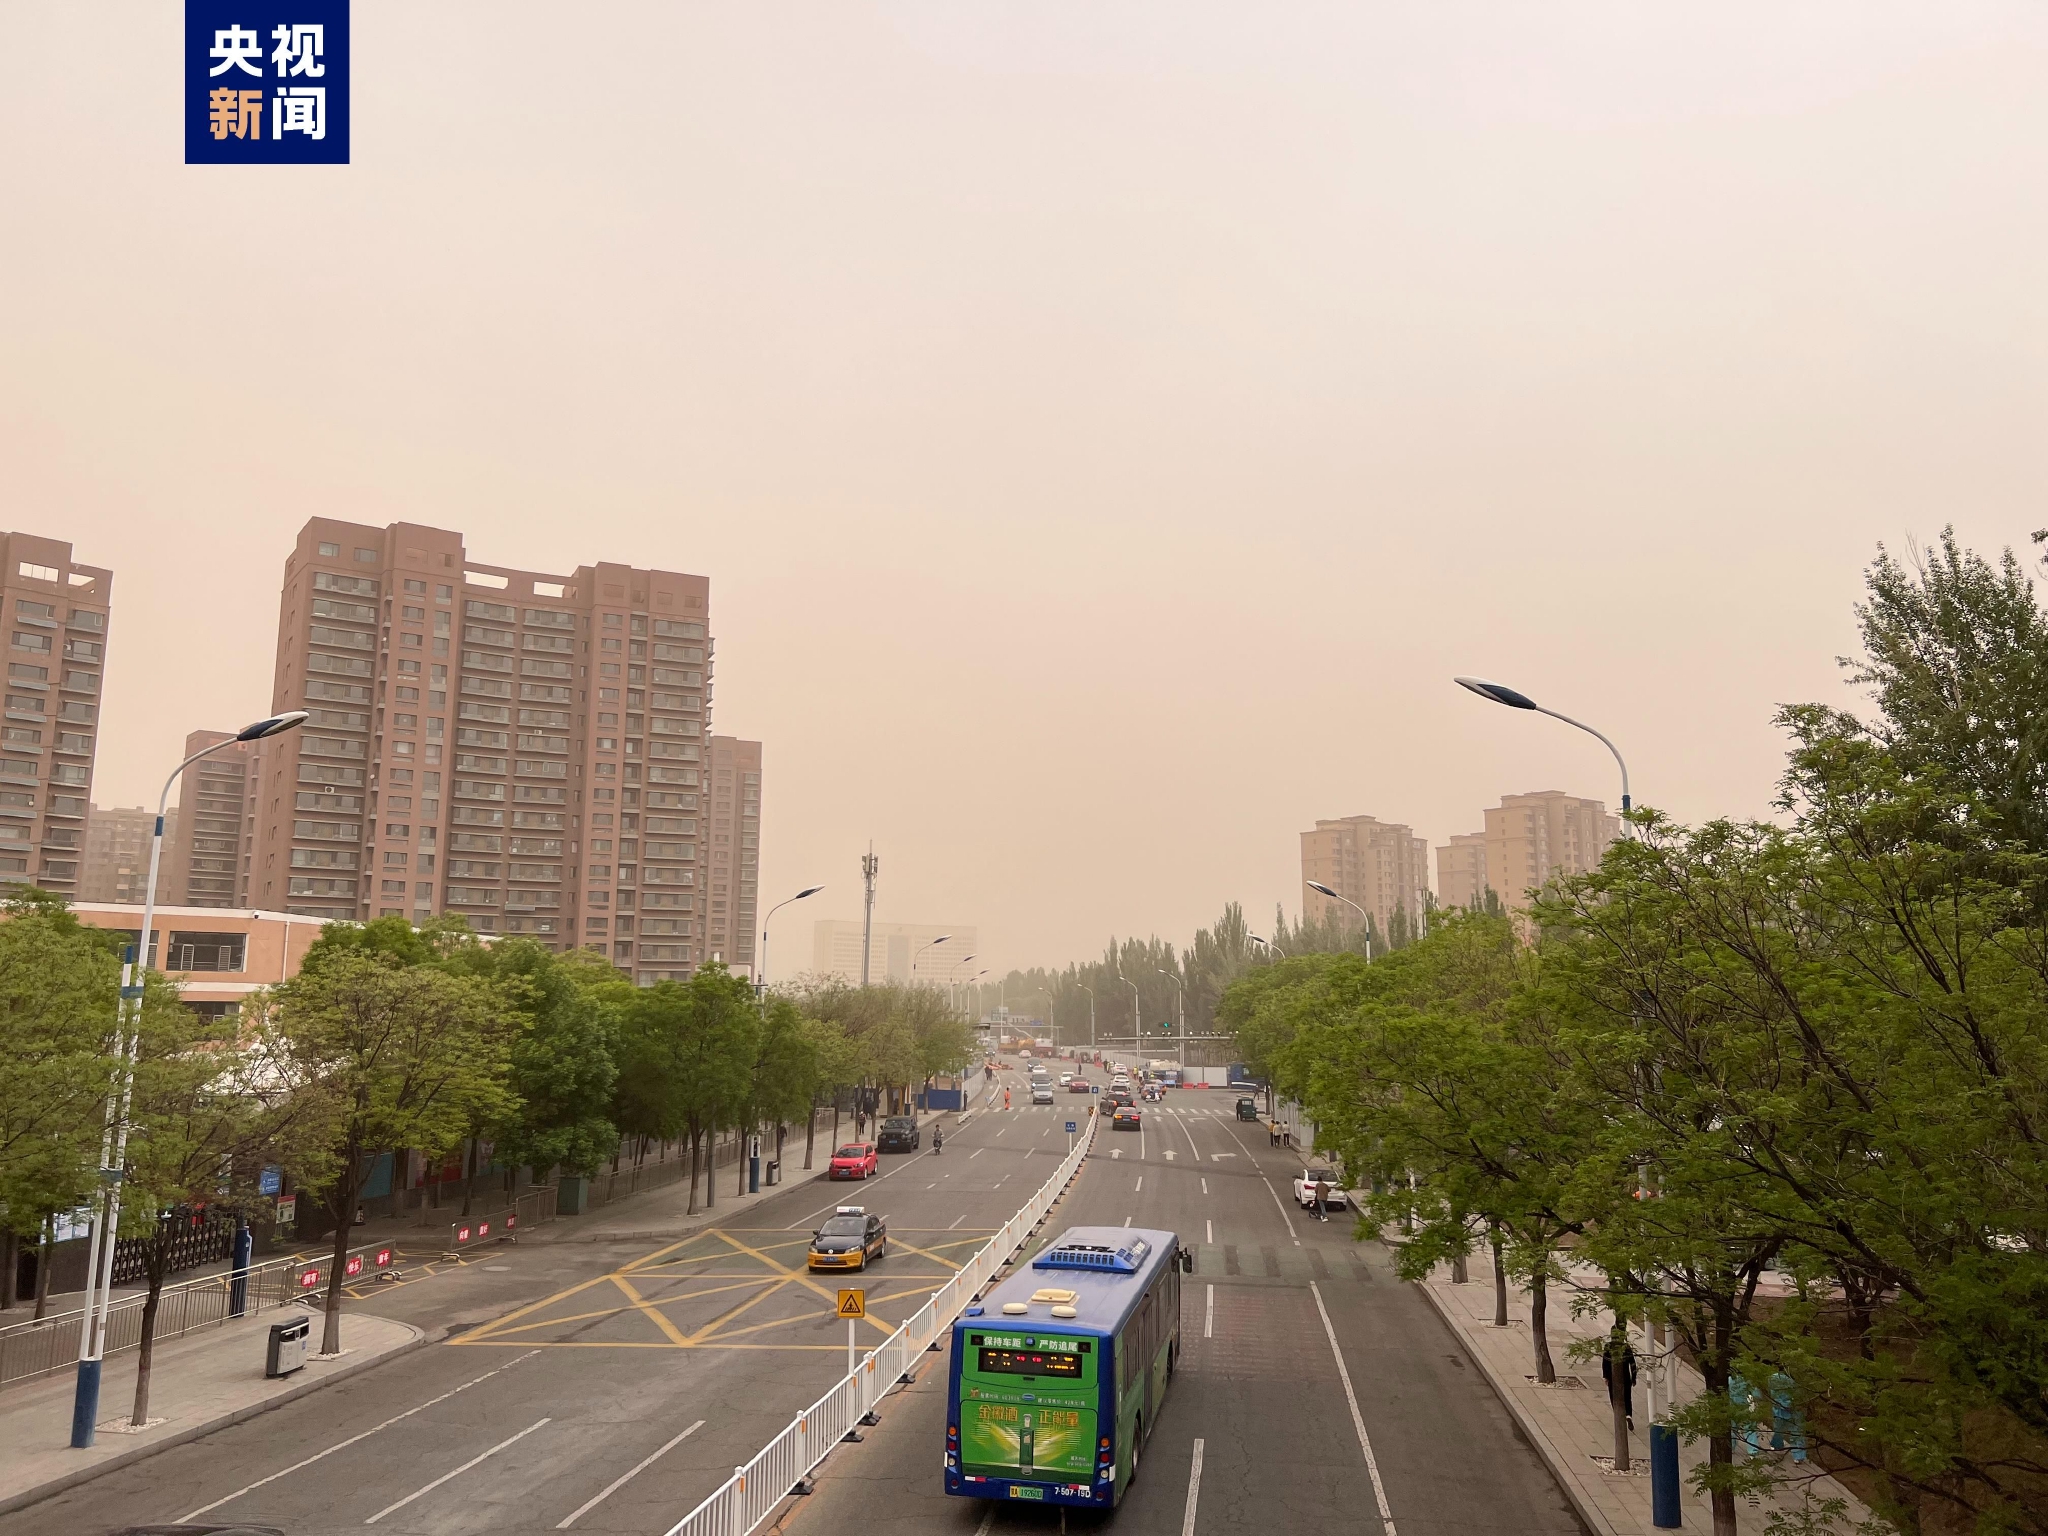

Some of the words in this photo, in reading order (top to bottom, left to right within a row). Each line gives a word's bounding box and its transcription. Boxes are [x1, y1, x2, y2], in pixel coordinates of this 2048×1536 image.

[983, 1336, 1022, 1348] 保持车距
[1038, 1339, 1078, 1352] 严防追尾
[978, 1404, 1019, 1422] 金徽酒
[1038, 1409, 1079, 1427] 正能量
